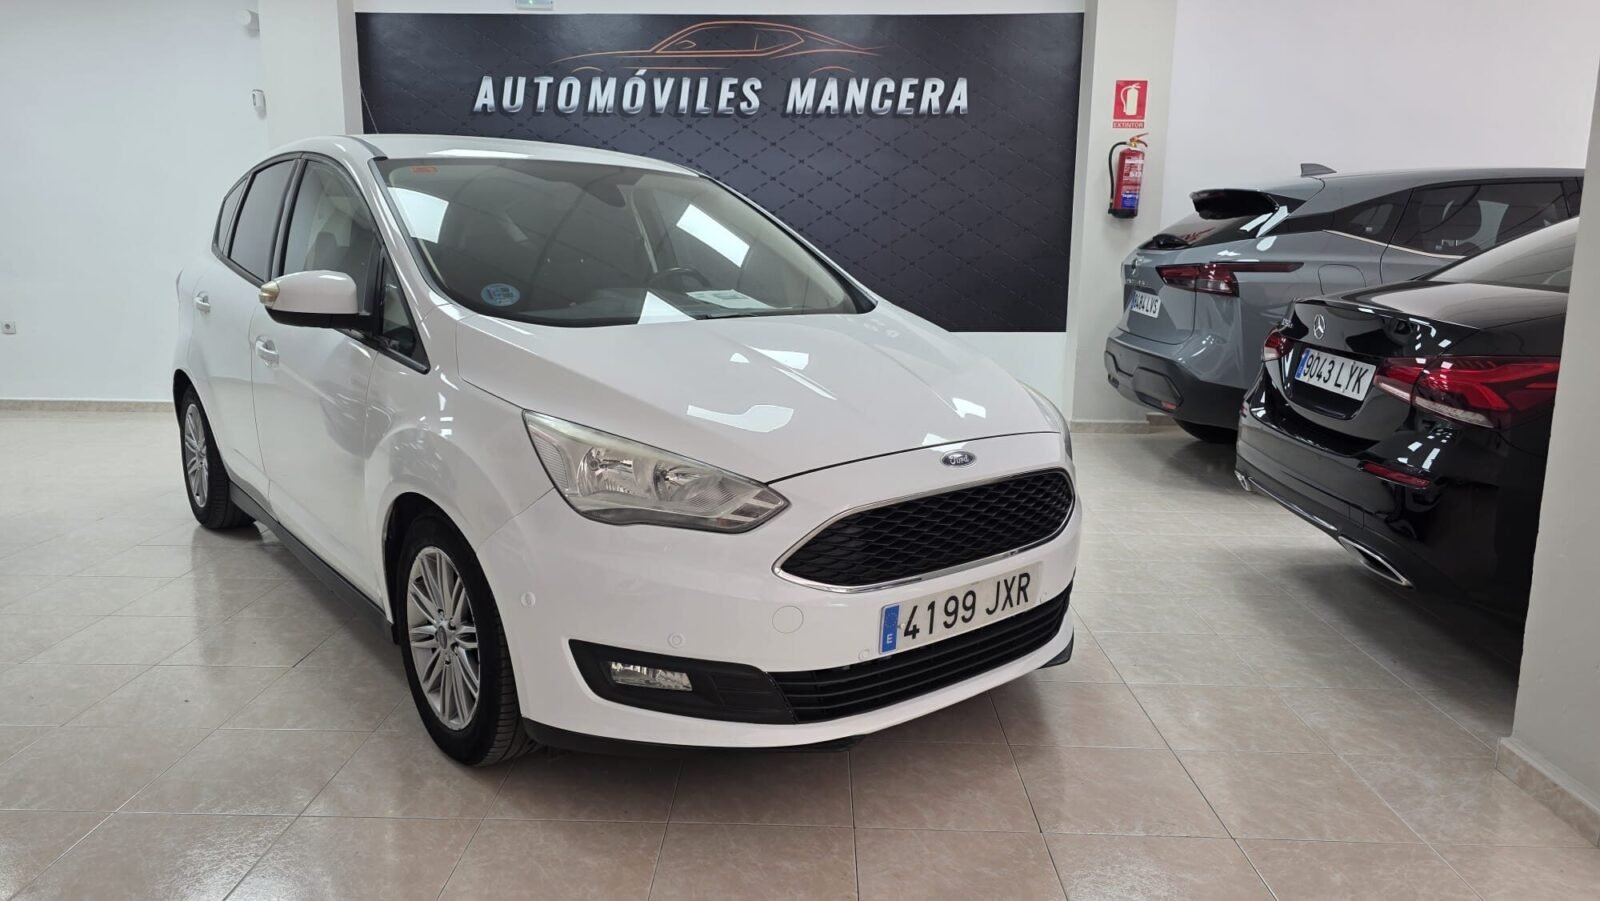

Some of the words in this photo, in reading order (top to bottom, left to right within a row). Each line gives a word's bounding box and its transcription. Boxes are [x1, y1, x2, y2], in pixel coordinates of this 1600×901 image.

[472, 69, 762, 115] AUTOMÓVILES
[786, 77, 970, 115] MANCERA
[1303, 354, 1335, 384] 9043
[1334, 361, 1369, 395] LYK
[949, 453, 970, 465] Ford
[903, 590, 977, 640] 4199
[985, 572, 1031, 616] JXR
